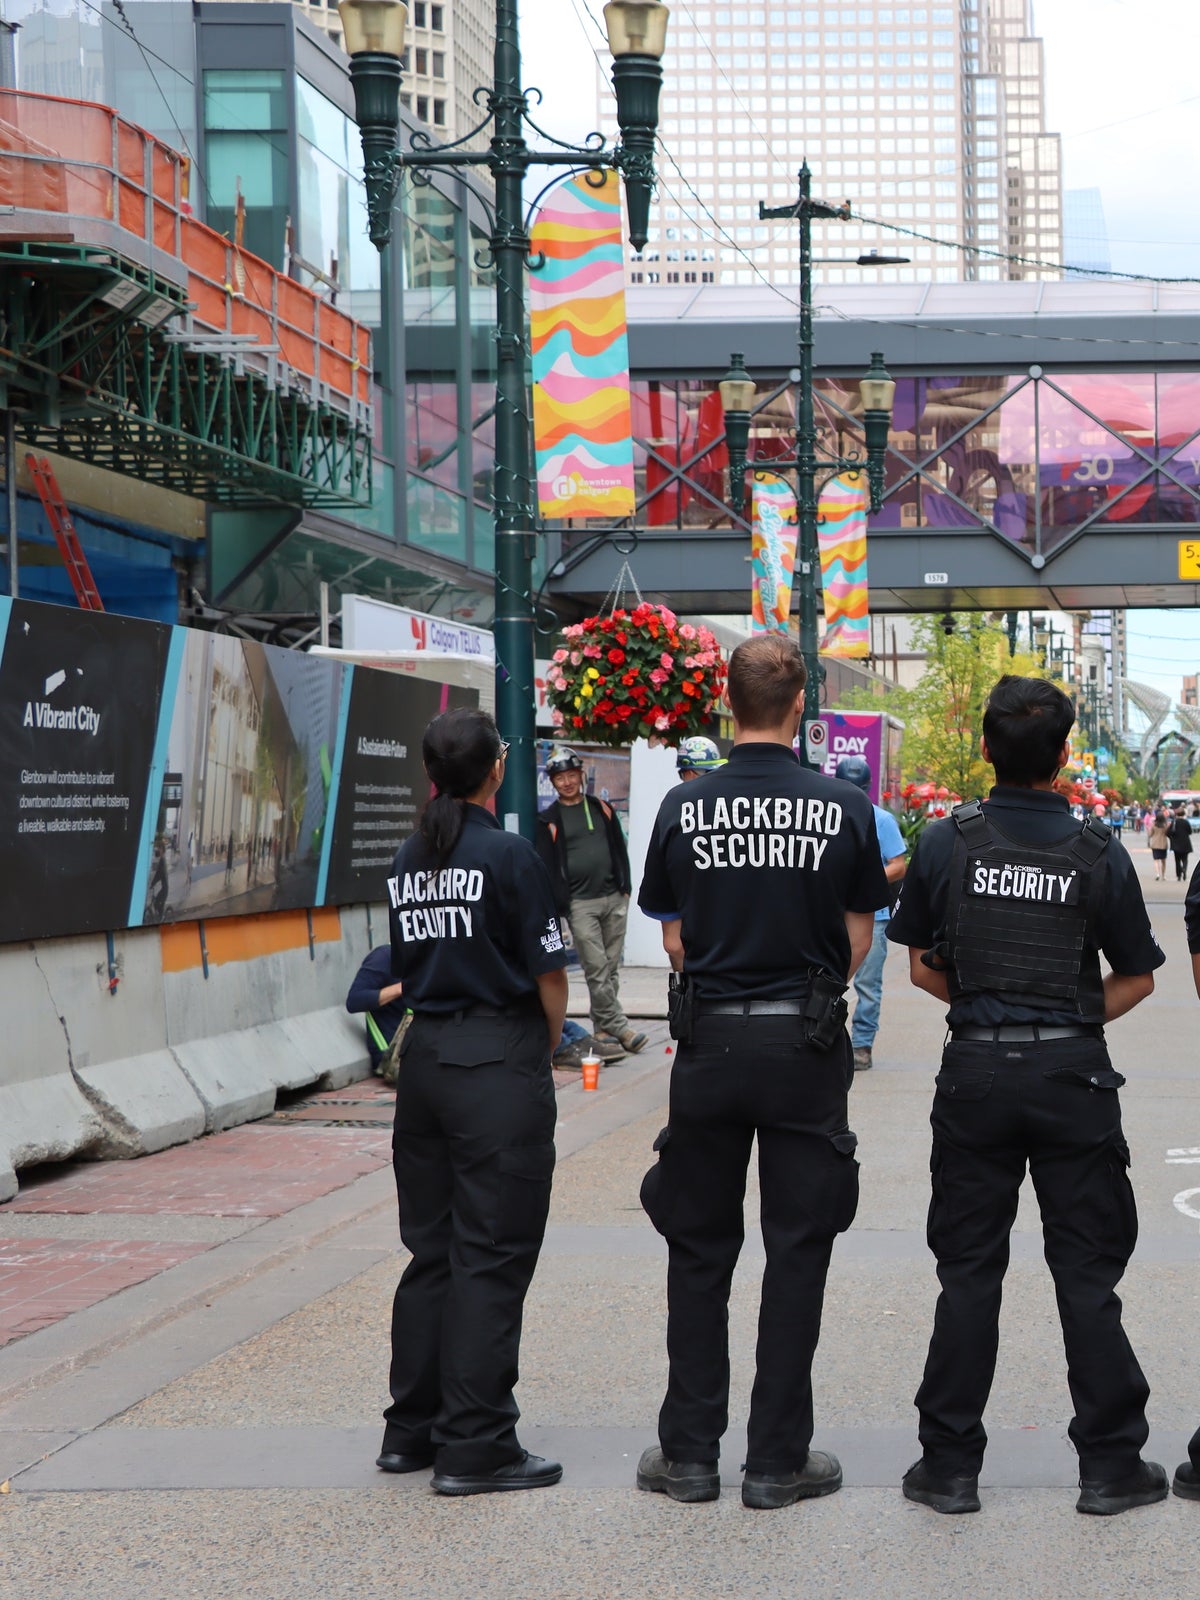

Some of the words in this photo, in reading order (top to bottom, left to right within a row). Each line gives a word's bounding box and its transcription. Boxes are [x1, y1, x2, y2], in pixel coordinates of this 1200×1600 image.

[1074, 453, 1114, 480] 50
[430, 622, 459, 652] Calgary
[460, 630, 480, 654] TELUS
[24, 701, 34, 727] A
[36, 702, 76, 729] Vibrant
[78, 705, 100, 736] City
[833, 736, 868, 753] DAY
[21, 769, 48, 784] Glenbow
[58, 771, 86, 784] contribute
[20, 795, 50, 808] downtown
[51, 795, 72, 807] cultural
[92, 795, 106, 807] while
[106, 795, 129, 809] fostering
[47, 818, 71, 831] walkable
[72, 818, 82, 830] and
[83, 818, 94, 830] safe
[680, 797, 843, 836] BLACKBIRD
[692, 833, 828, 872] SECURITY
[1004, 864, 1042, 874] BLACKBIRD
[973, 867, 1072, 902] SECURITY
